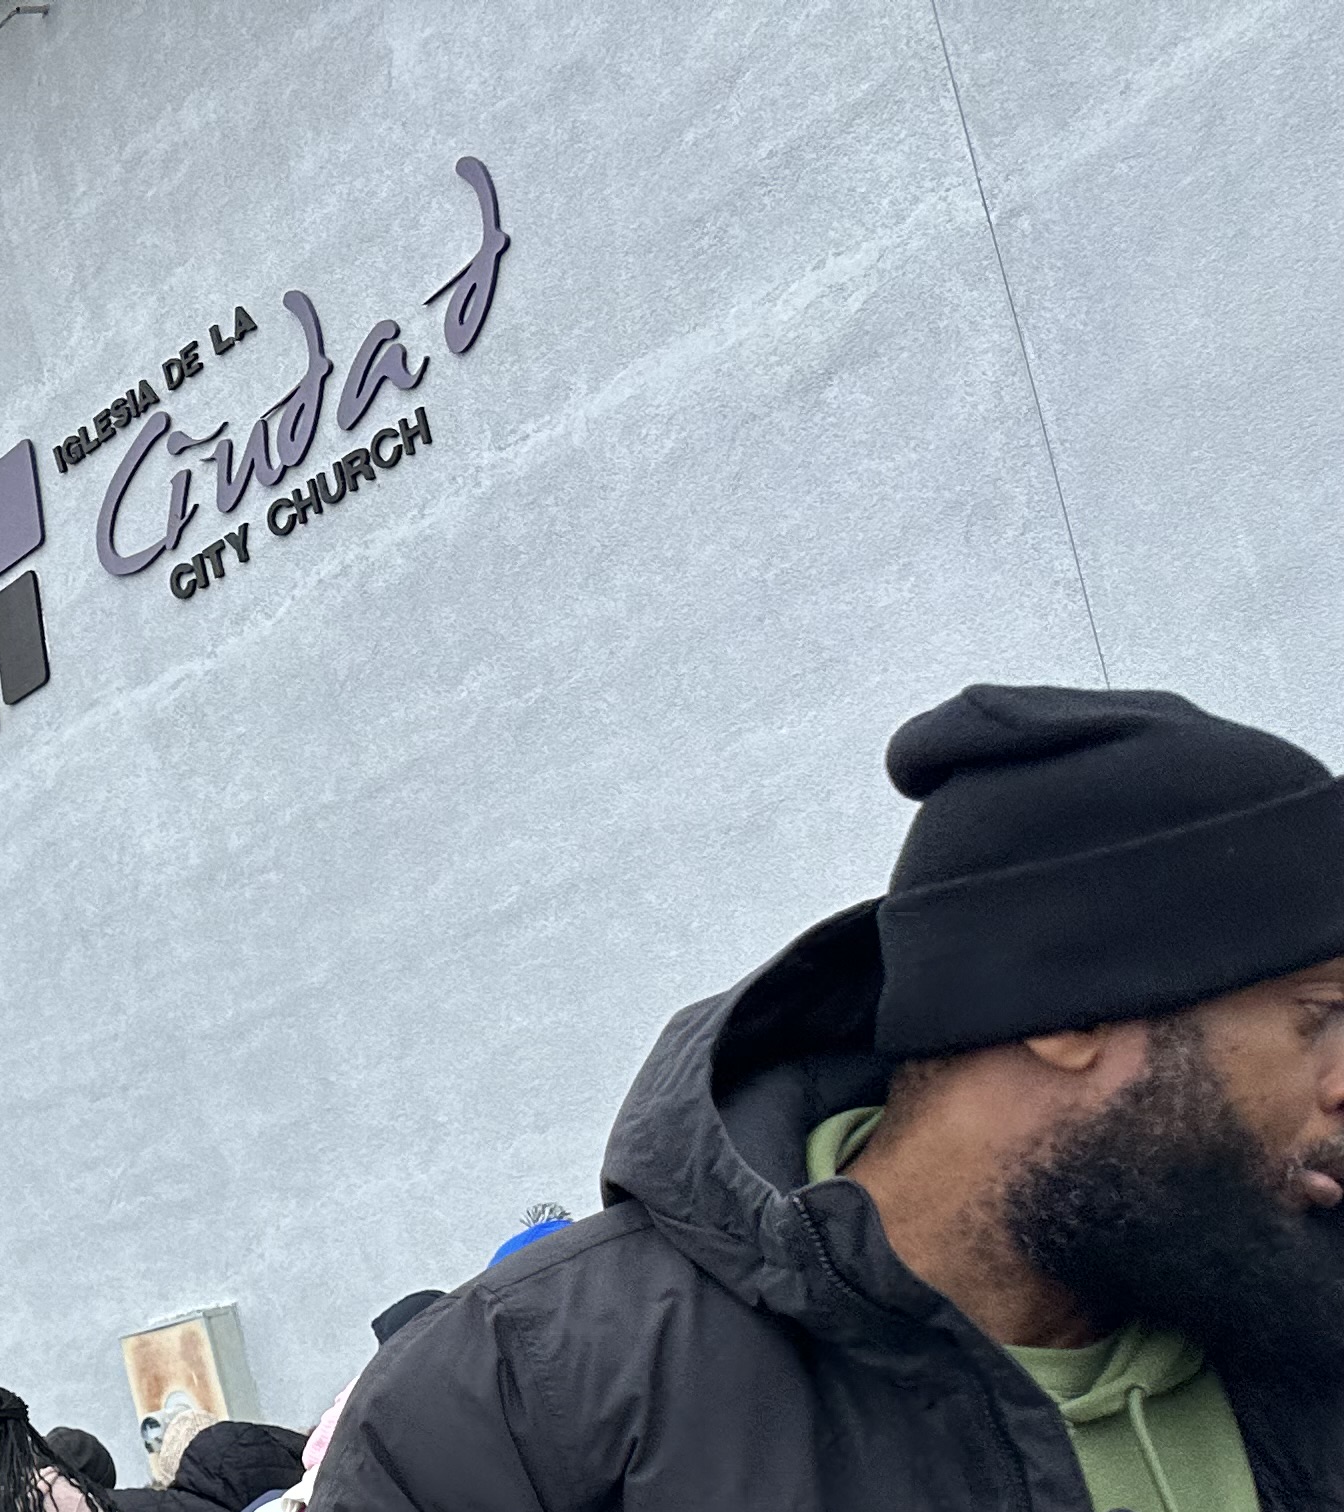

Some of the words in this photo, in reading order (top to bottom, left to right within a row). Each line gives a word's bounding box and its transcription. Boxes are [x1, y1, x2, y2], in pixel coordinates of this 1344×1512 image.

[52, 380, 160, 473] IGLESIA
[162, 341, 203, 391] DE
[211, 306, 257, 355] LA
[96, 156, 511, 576] Ciudad
[170, 523, 250, 600] CITY
[266, 407, 433, 536] CHURCH
